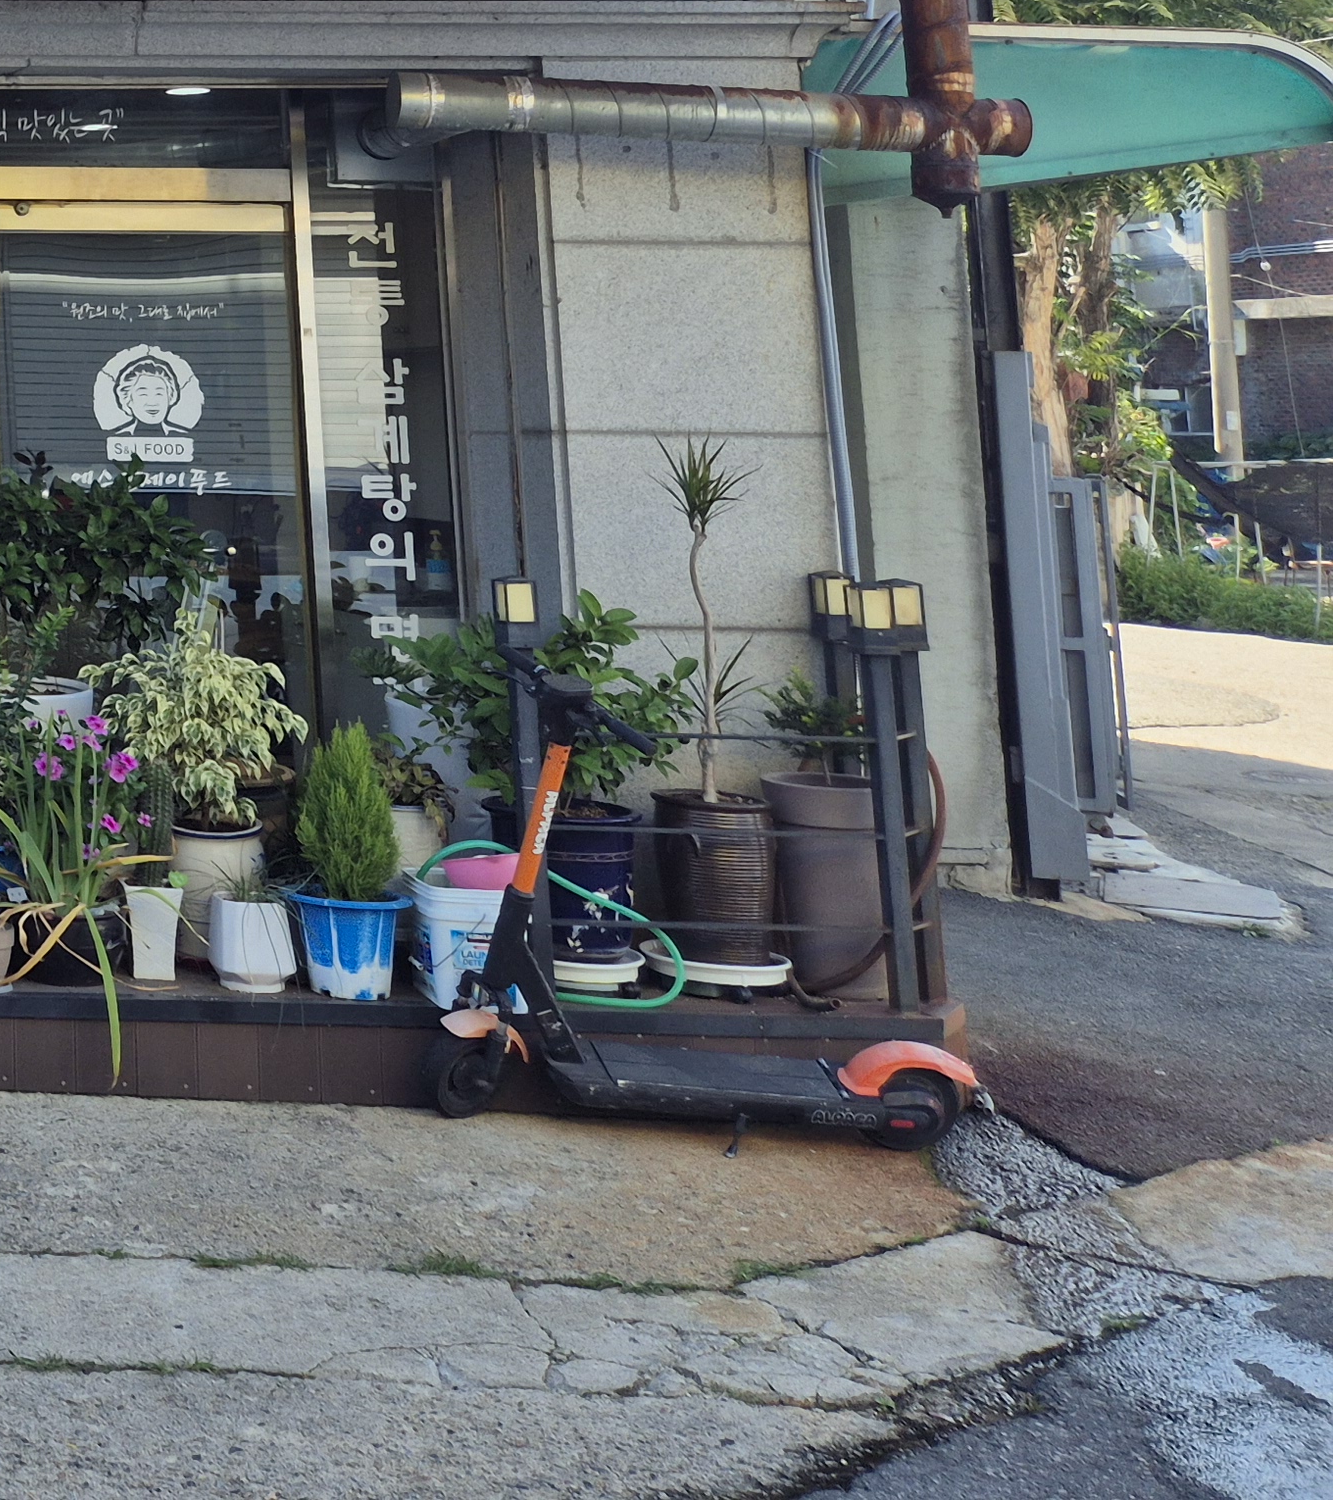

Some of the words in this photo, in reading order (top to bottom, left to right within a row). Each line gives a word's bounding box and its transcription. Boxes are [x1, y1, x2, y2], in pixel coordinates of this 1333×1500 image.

[18, 108, 88, 144] 맛있는
[144, 442, 185, 455] FOOD
[355, 357, 417, 582] 삼계탕의
